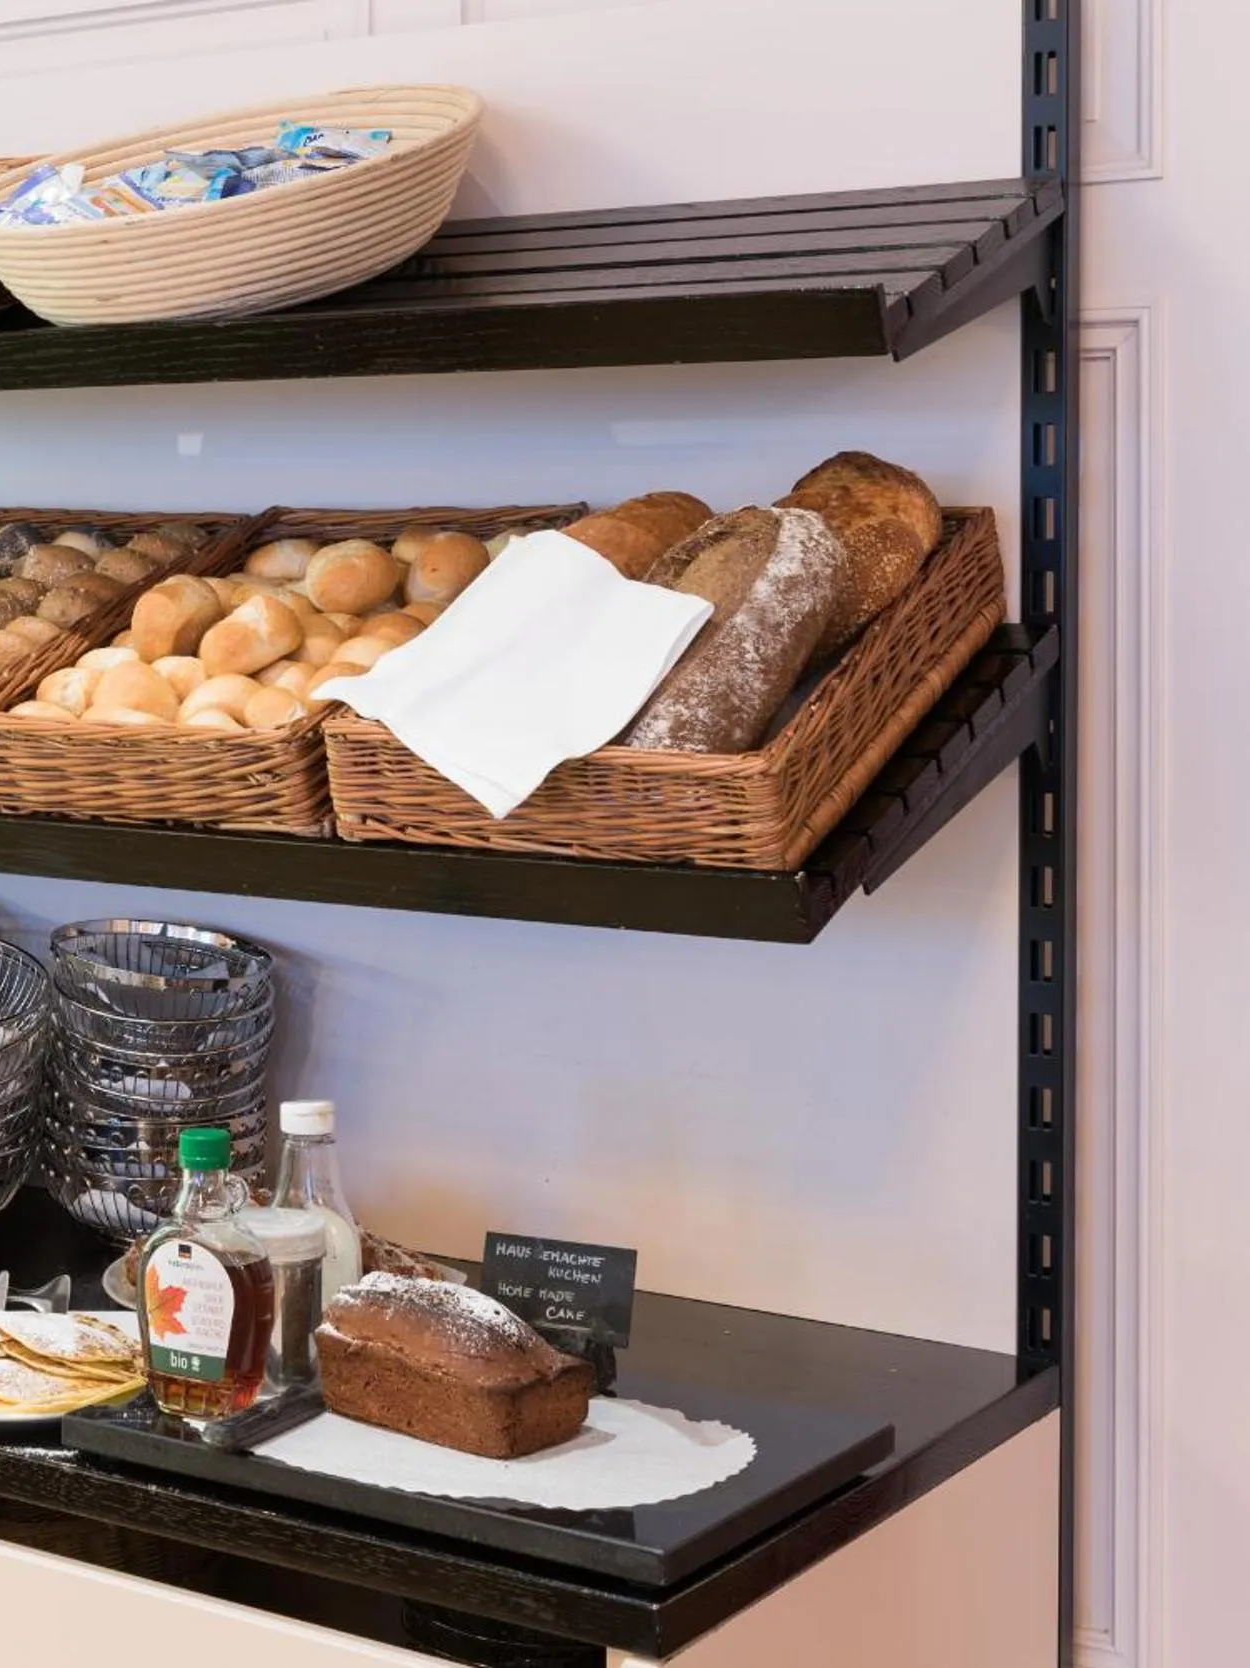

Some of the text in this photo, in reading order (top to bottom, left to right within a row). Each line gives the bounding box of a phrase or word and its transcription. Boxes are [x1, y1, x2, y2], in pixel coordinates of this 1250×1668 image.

[548, 1265, 602, 1284] KUCHEN
[498, 1280, 576, 1302] HOME MADE
[546, 1306, 586, 1320] CAKE
[170, 1352, 188, 1369] bio
